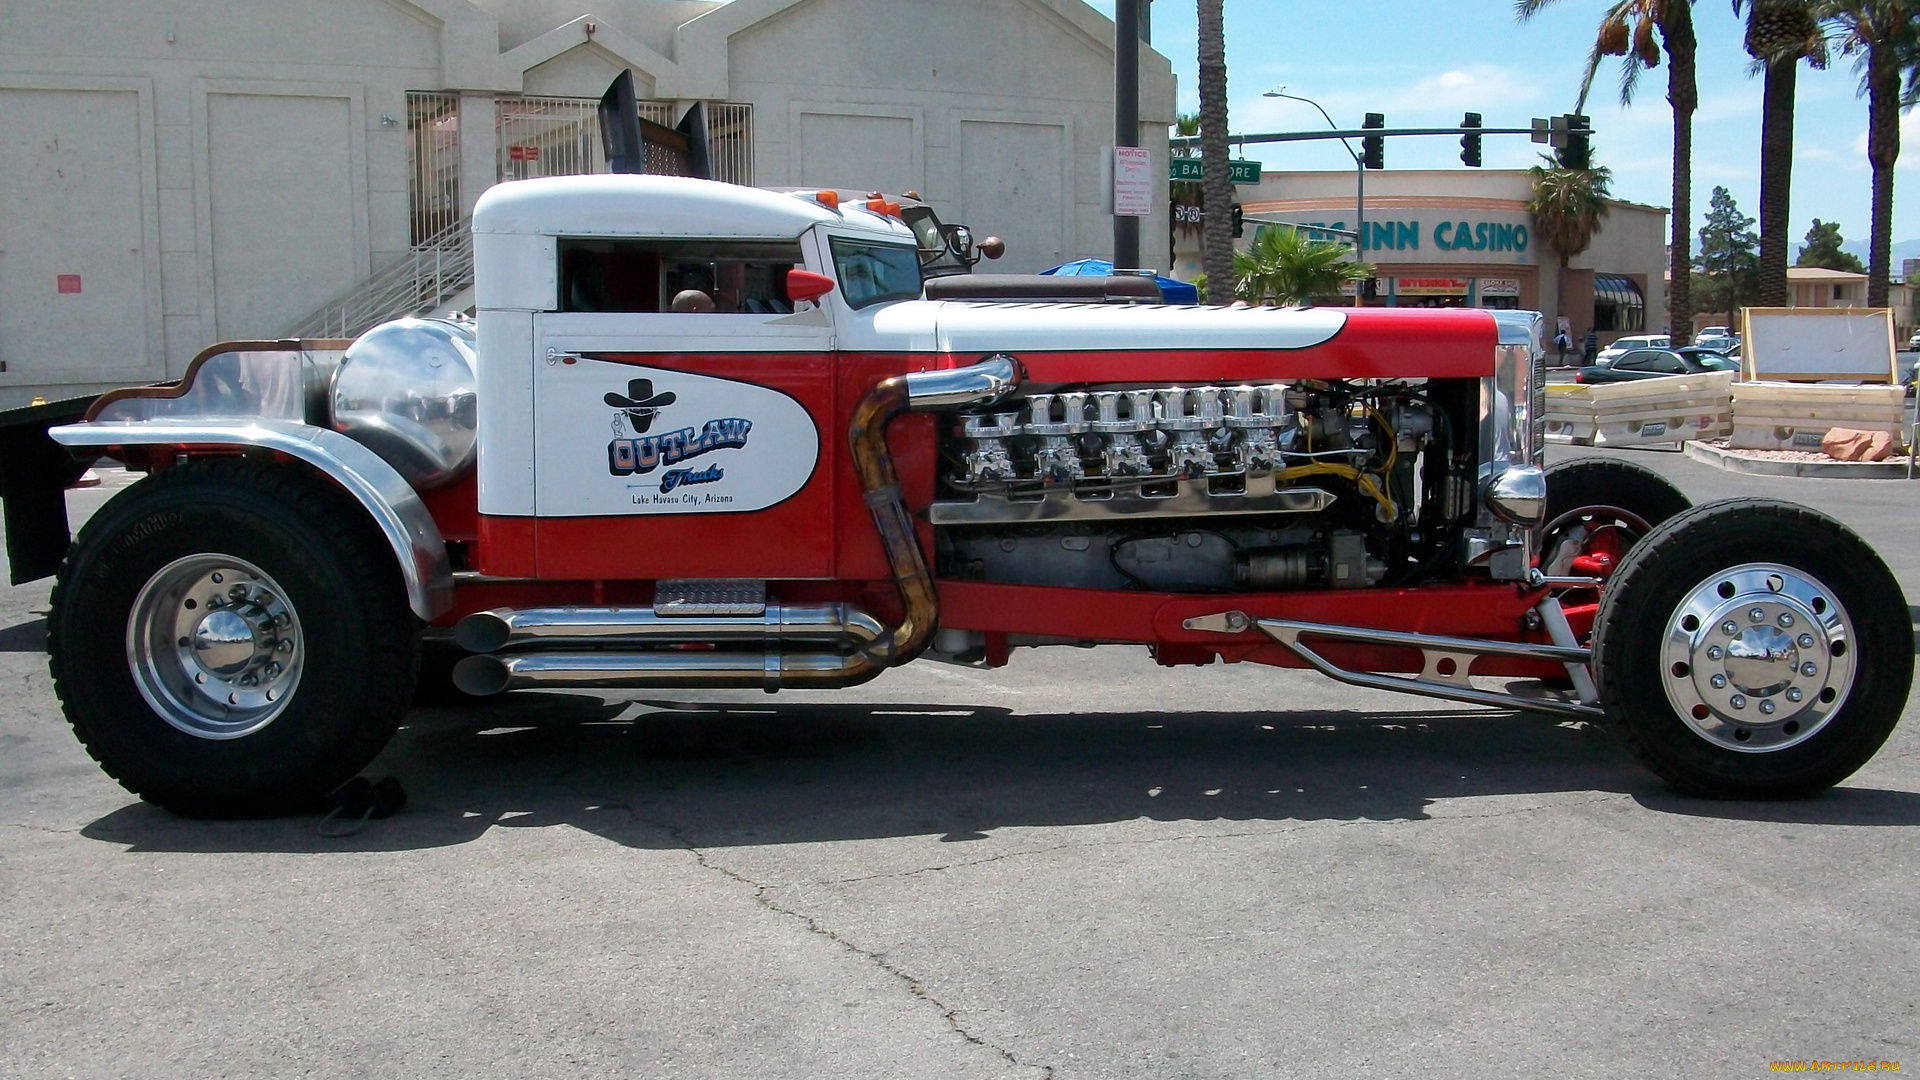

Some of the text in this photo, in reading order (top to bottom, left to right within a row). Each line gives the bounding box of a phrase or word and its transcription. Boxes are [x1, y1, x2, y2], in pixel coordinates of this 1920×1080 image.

[1182, 164, 1251, 178] BALORE
[1362, 221, 1419, 250] INN
[1434, 221, 1528, 252] CASINO
[608, 418, 752, 475] OUTLAW
[660, 463, 724, 493] Trucks
[632, 493, 733, 506] Lake Havasu City, Arizona
